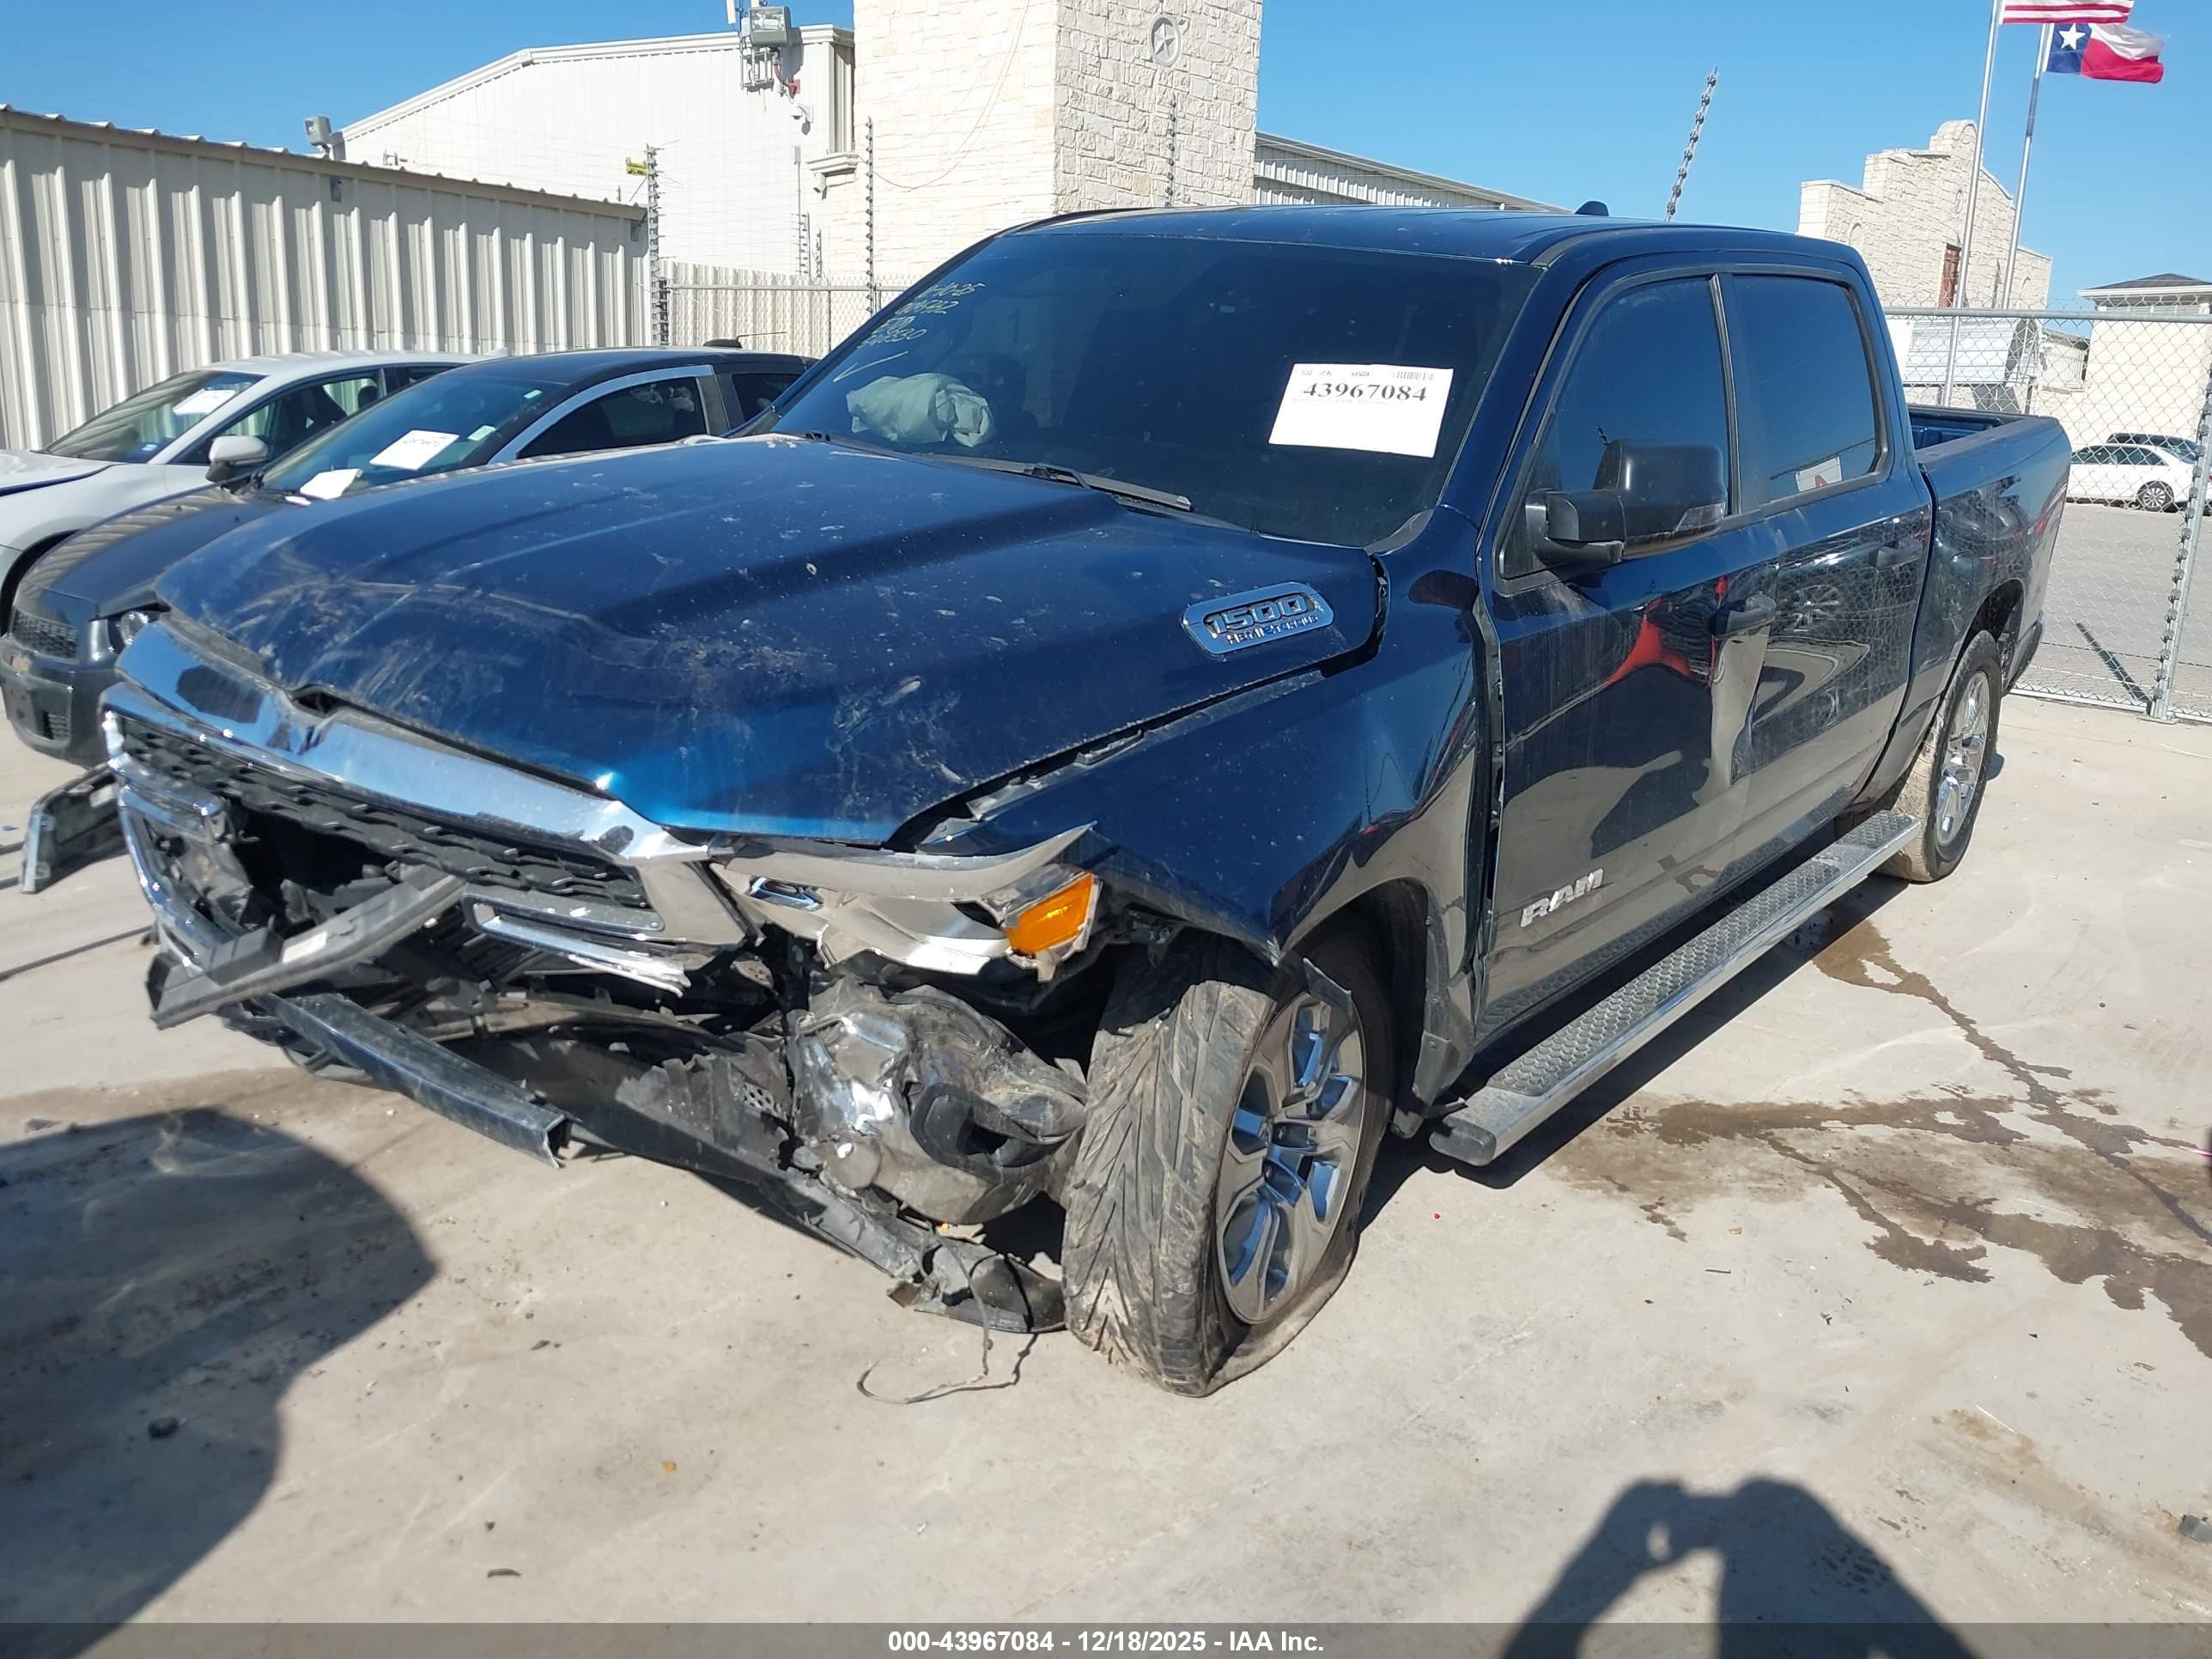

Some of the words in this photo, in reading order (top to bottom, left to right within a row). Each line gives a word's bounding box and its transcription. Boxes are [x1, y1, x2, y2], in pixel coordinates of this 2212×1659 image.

[1303, 381, 1427, 402] 43967084
[1205, 594, 1308, 638] 1500
[1519, 867, 1605, 927] RAM
